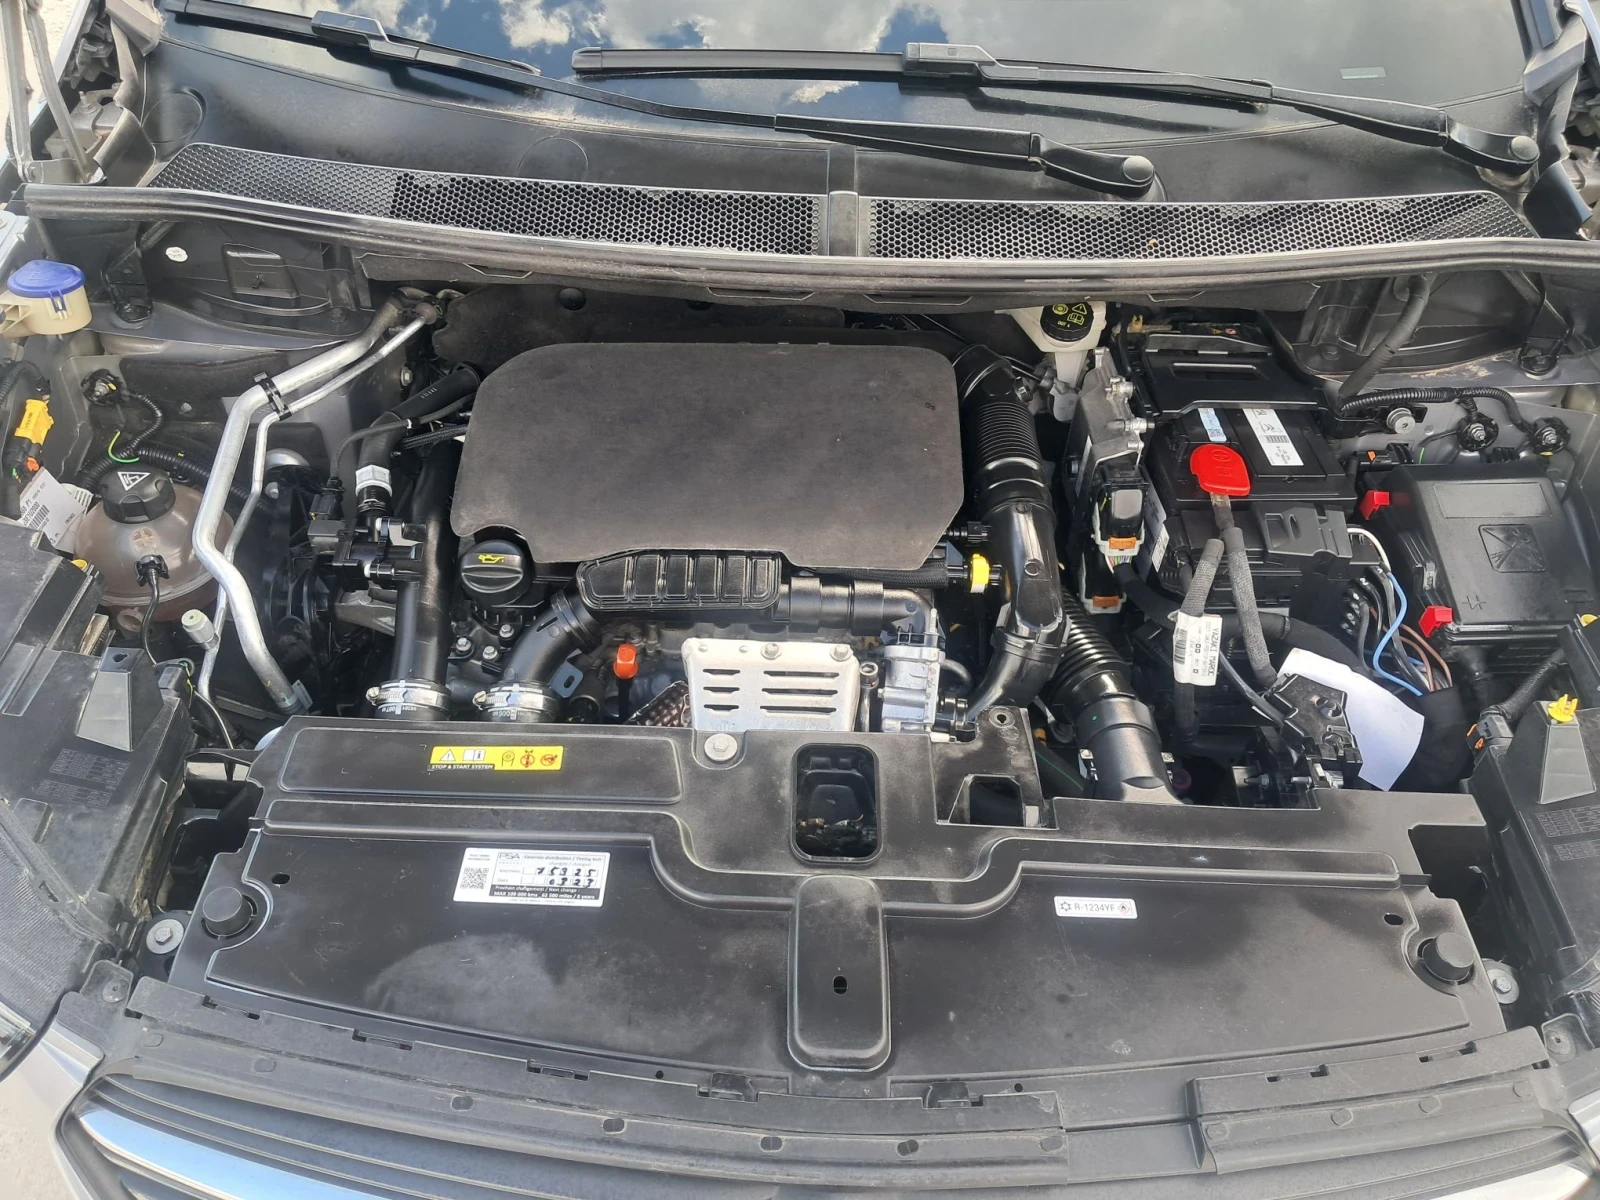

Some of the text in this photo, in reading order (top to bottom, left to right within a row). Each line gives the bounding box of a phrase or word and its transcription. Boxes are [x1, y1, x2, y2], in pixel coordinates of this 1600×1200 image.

[1207, 627, 1220, 676] YAZAKI MAROC
[499, 852, 520, 860] PSA
[1073, 902, 1115, 912] R-1234YF
